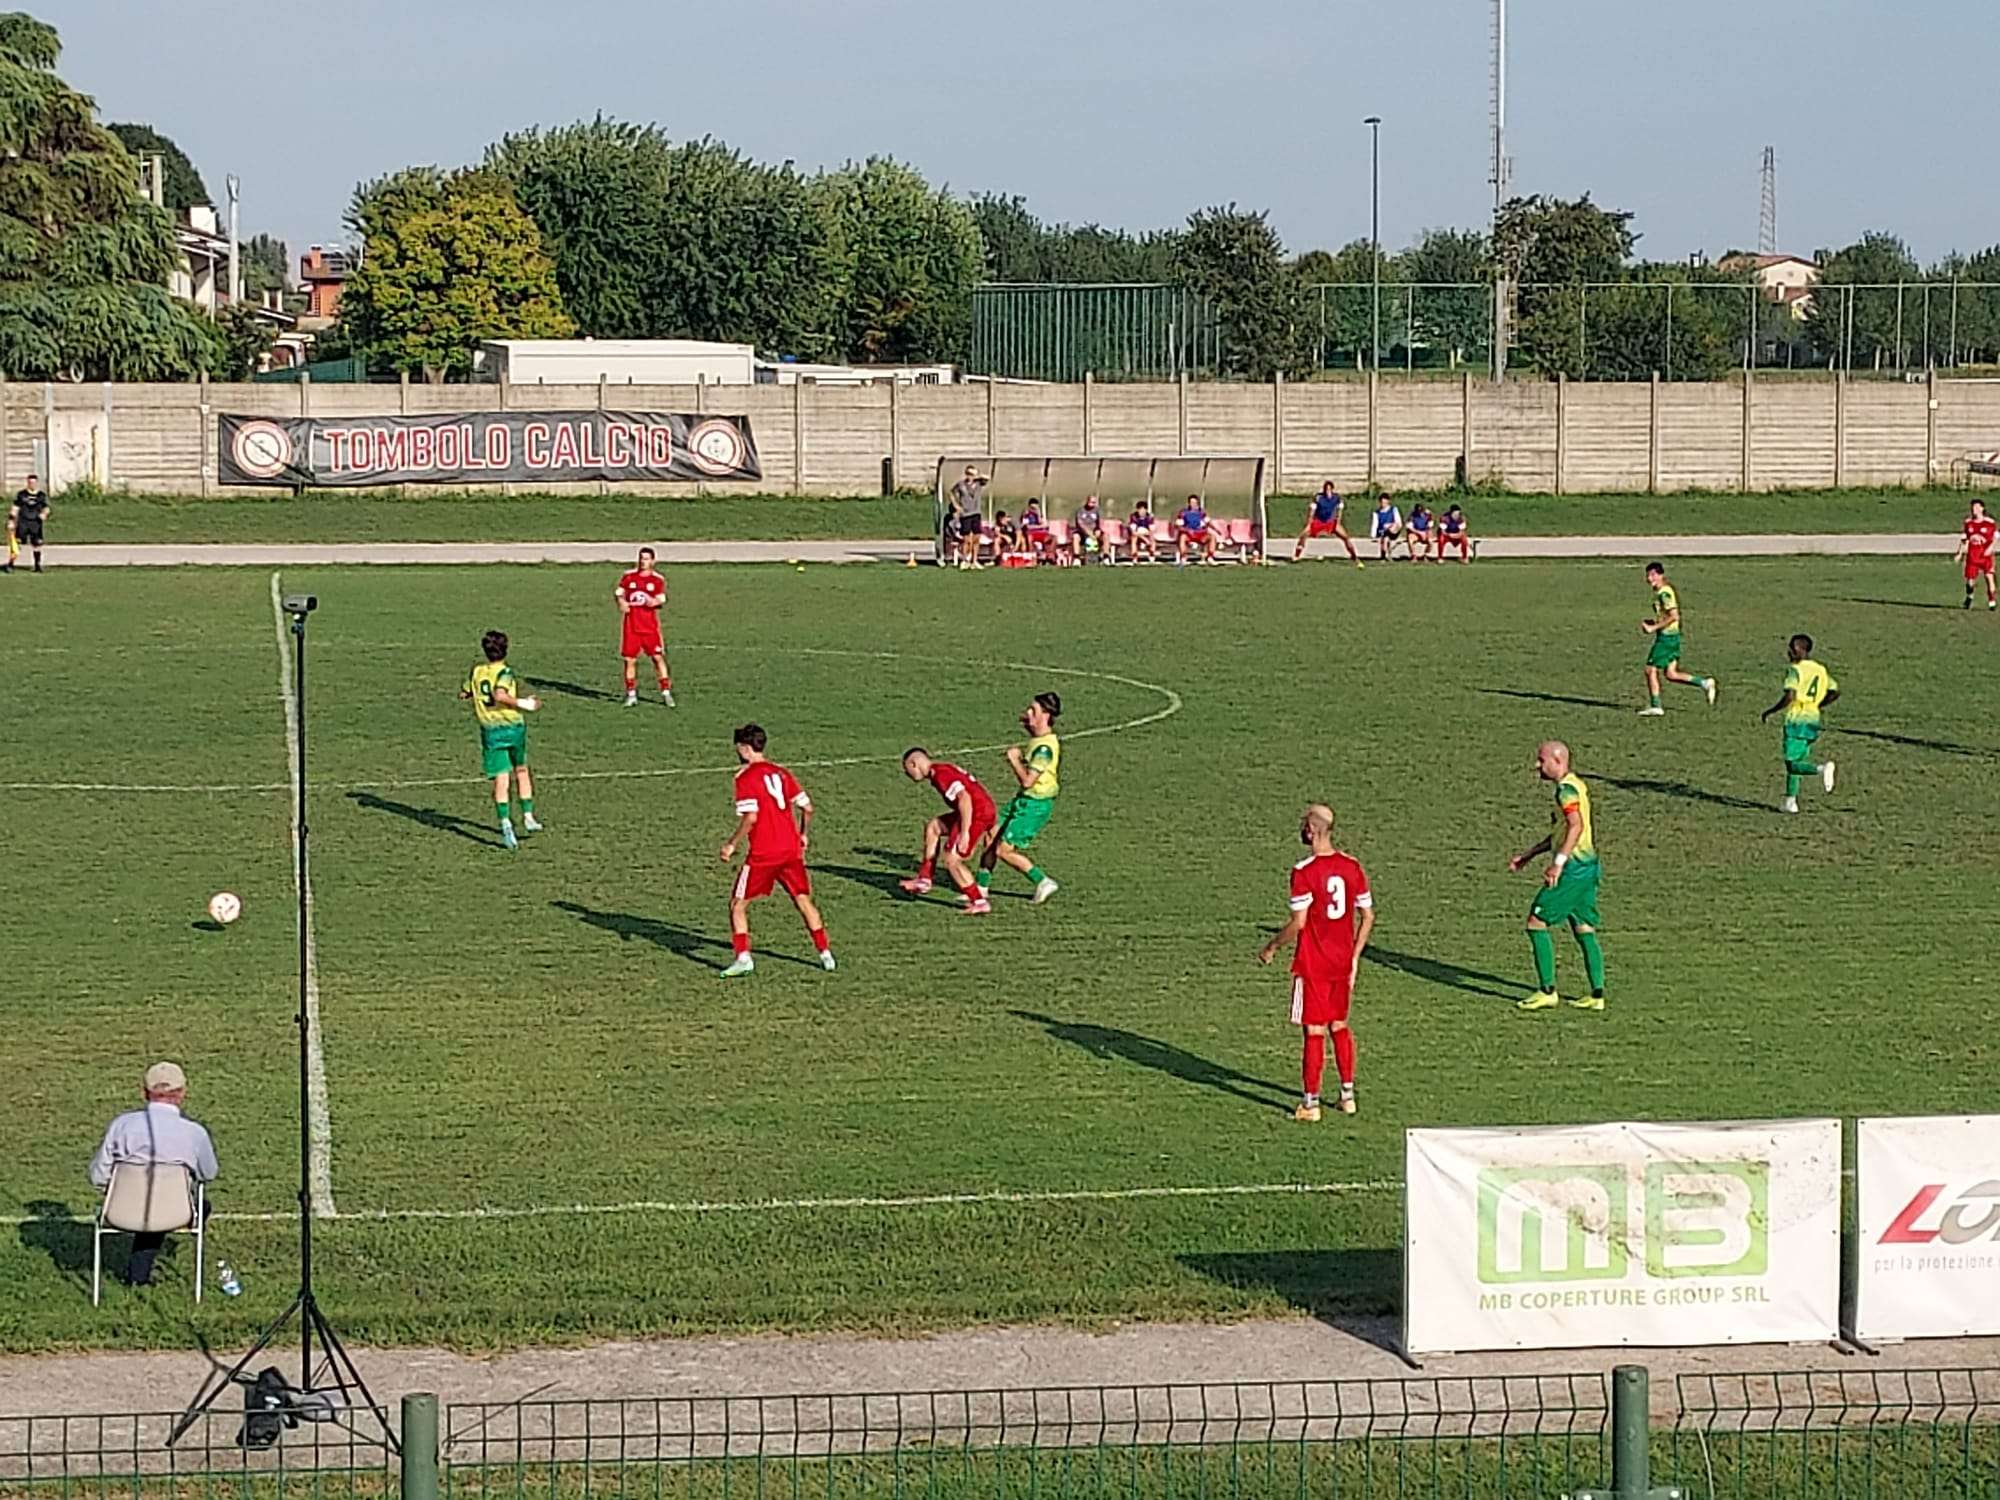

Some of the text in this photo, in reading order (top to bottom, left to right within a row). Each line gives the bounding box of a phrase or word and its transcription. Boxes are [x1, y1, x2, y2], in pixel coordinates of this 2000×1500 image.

[323, 421, 672, 473] TOMBOLO CALCIO
[481, 679, 496, 706] 9
[1806, 675, 1819, 702] 4
[763, 773, 786, 810] 4
[1327, 875, 1346, 920] 3
[1876, 1179, 2000, 1245] LO
[1874, 1254, 1994, 1274] per la protezione
[1479, 1285, 1770, 1311] MB COPERTURE GROUP SRL
